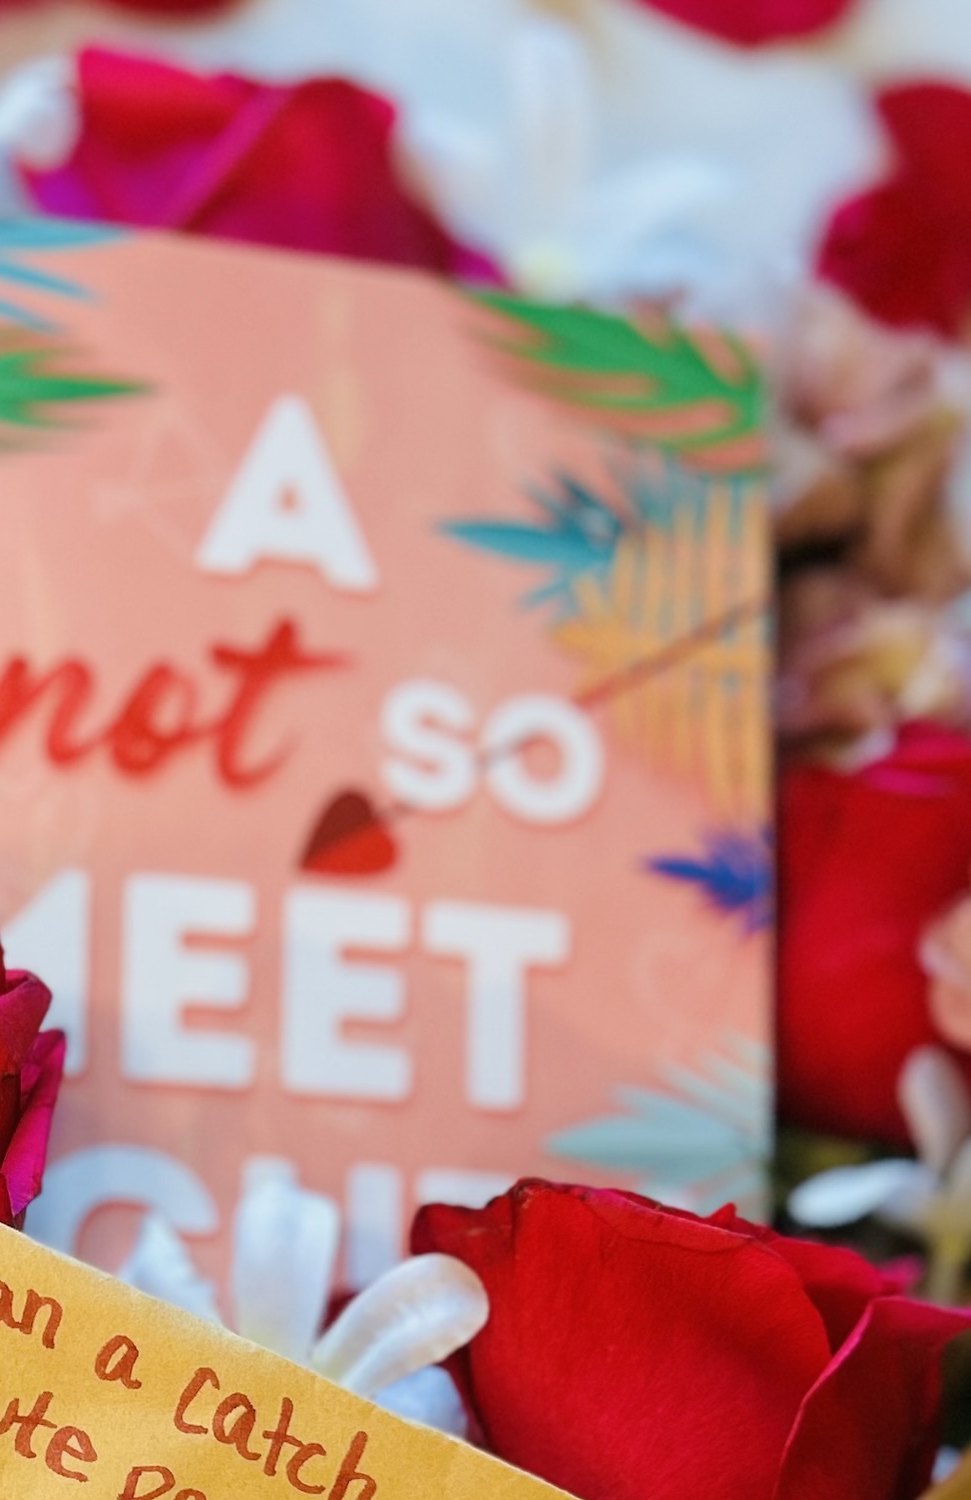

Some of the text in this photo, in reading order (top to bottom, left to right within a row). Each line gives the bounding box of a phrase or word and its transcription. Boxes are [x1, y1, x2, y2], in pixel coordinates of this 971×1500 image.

[194, 393, 380, 591] A
[377, 677, 607, 826] SO
[95, 1334, 143, 1390] a
